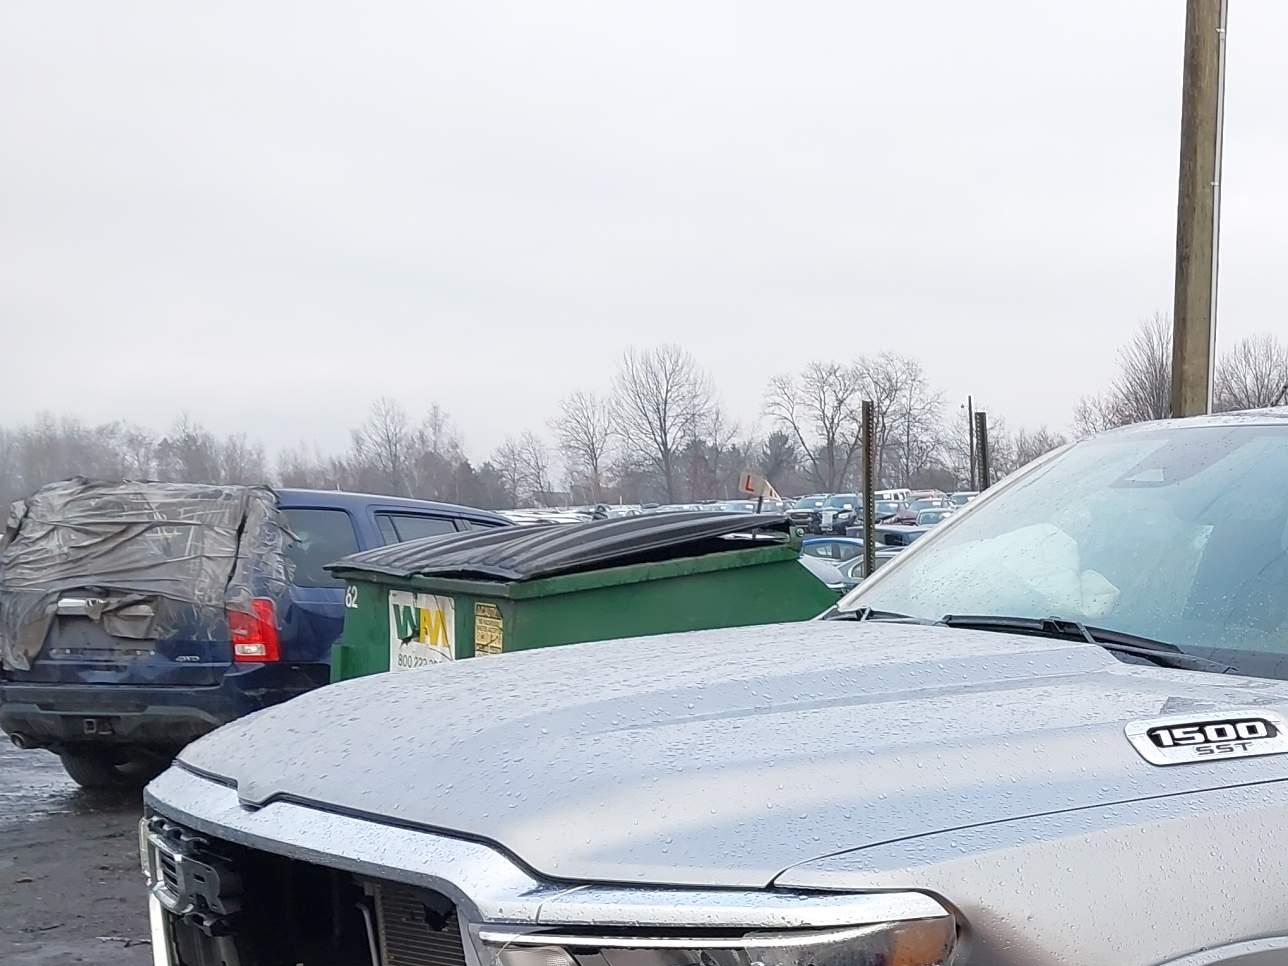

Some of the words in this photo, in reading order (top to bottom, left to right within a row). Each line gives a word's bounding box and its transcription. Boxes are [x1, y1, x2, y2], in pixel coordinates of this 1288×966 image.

[345, 585, 358, 608] 62
[392, 604, 450, 648] WM
[398, 653, 413, 668] 800
[1152, 721, 1268, 747] 1500
[1195, 742, 1252, 756] SST
